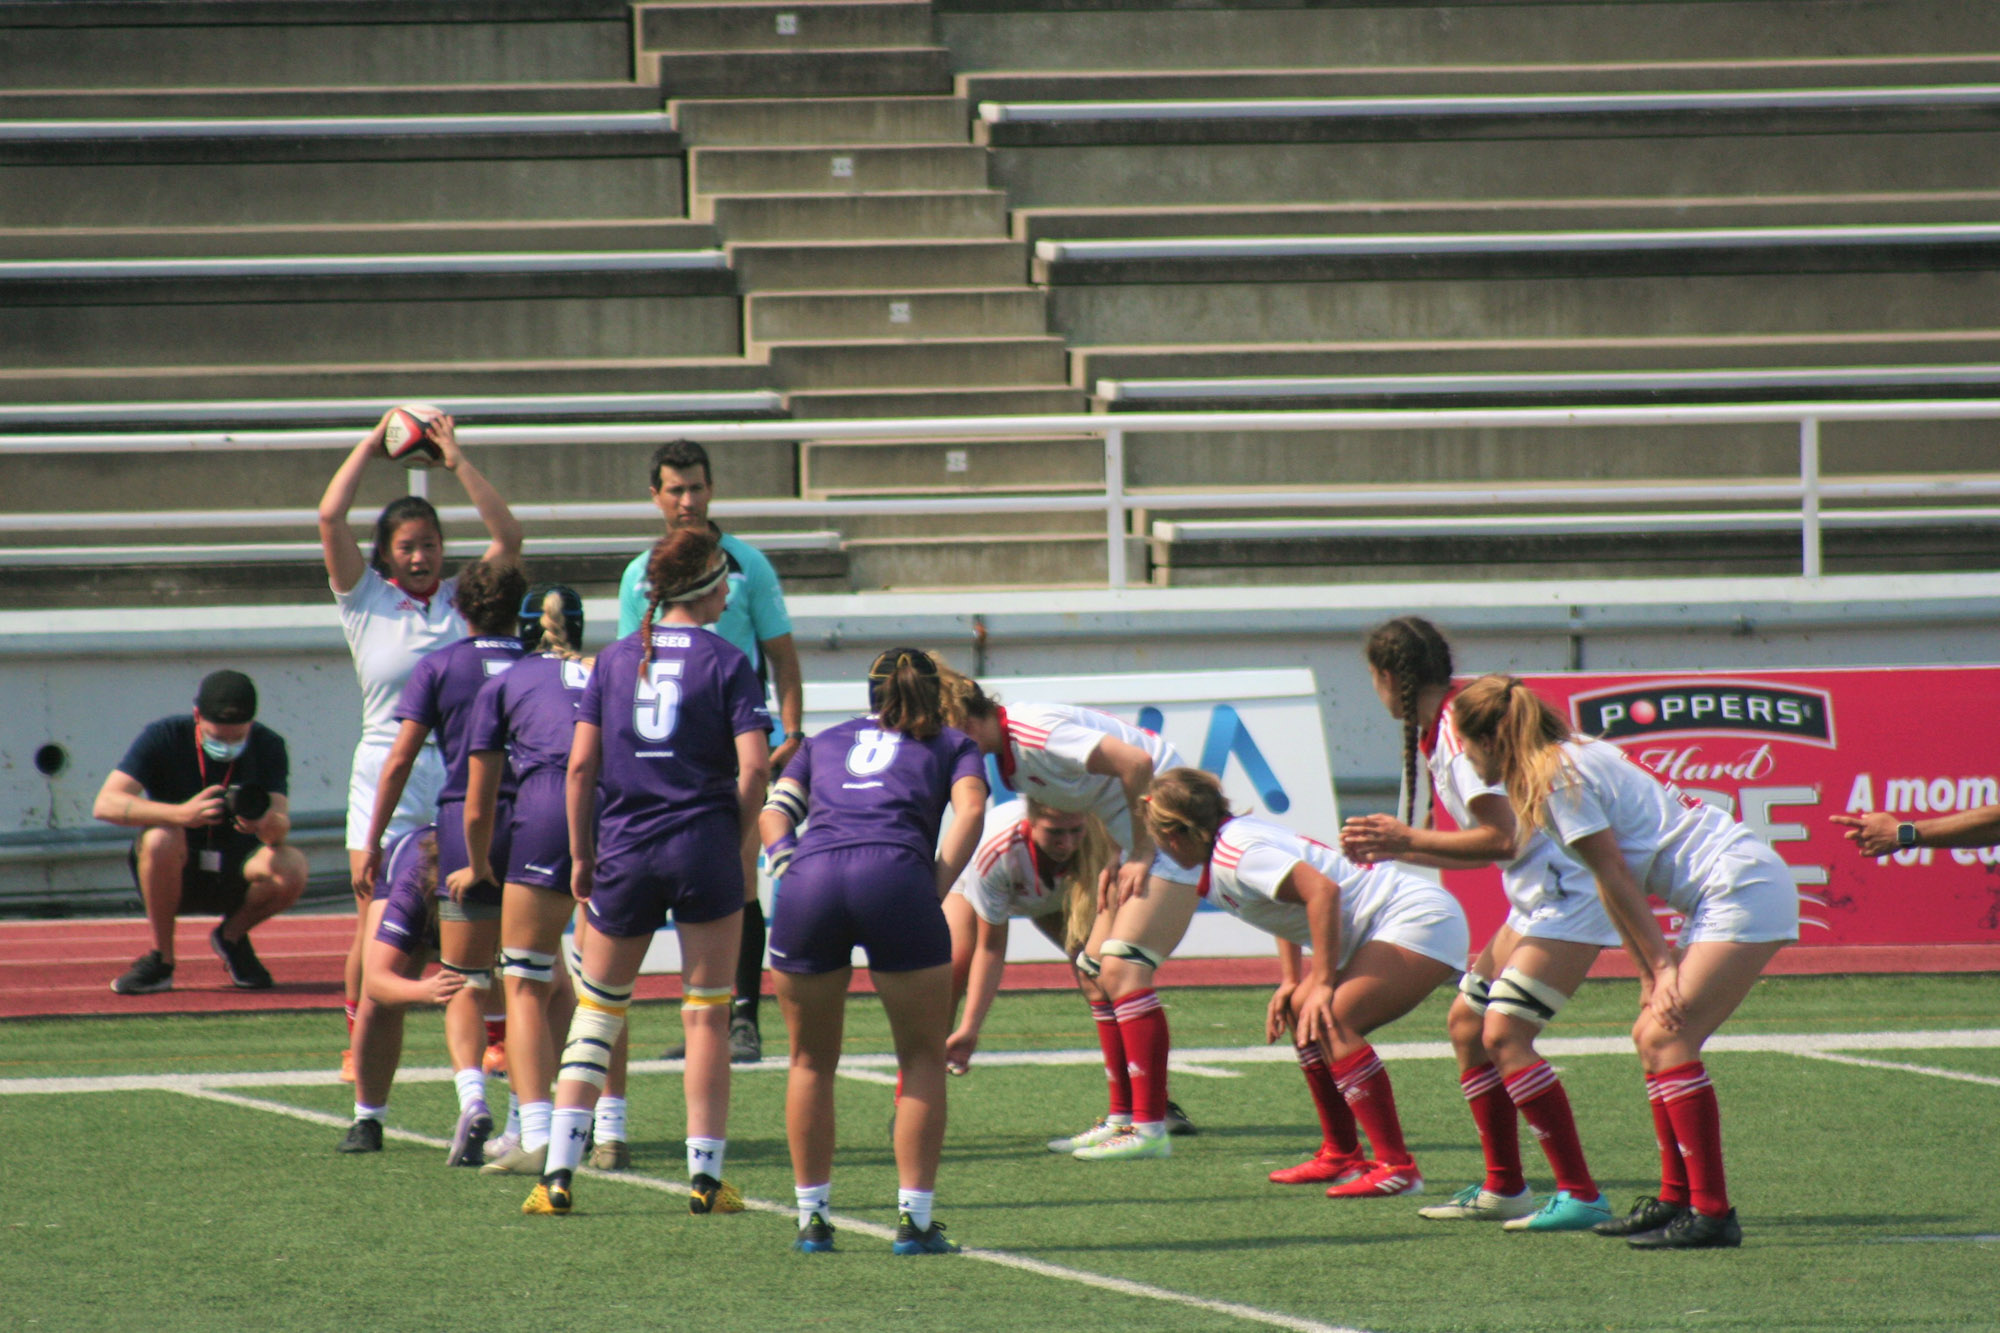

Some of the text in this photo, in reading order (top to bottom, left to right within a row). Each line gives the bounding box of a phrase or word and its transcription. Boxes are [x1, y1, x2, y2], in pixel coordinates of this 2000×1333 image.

[642, 631, 691, 648] SEQ
[633, 659, 684, 743] 5
[846, 728, 903, 777] 8
[1639, 744, 1775, 781] Hard
[1846, 773, 2000, 813] A mom
